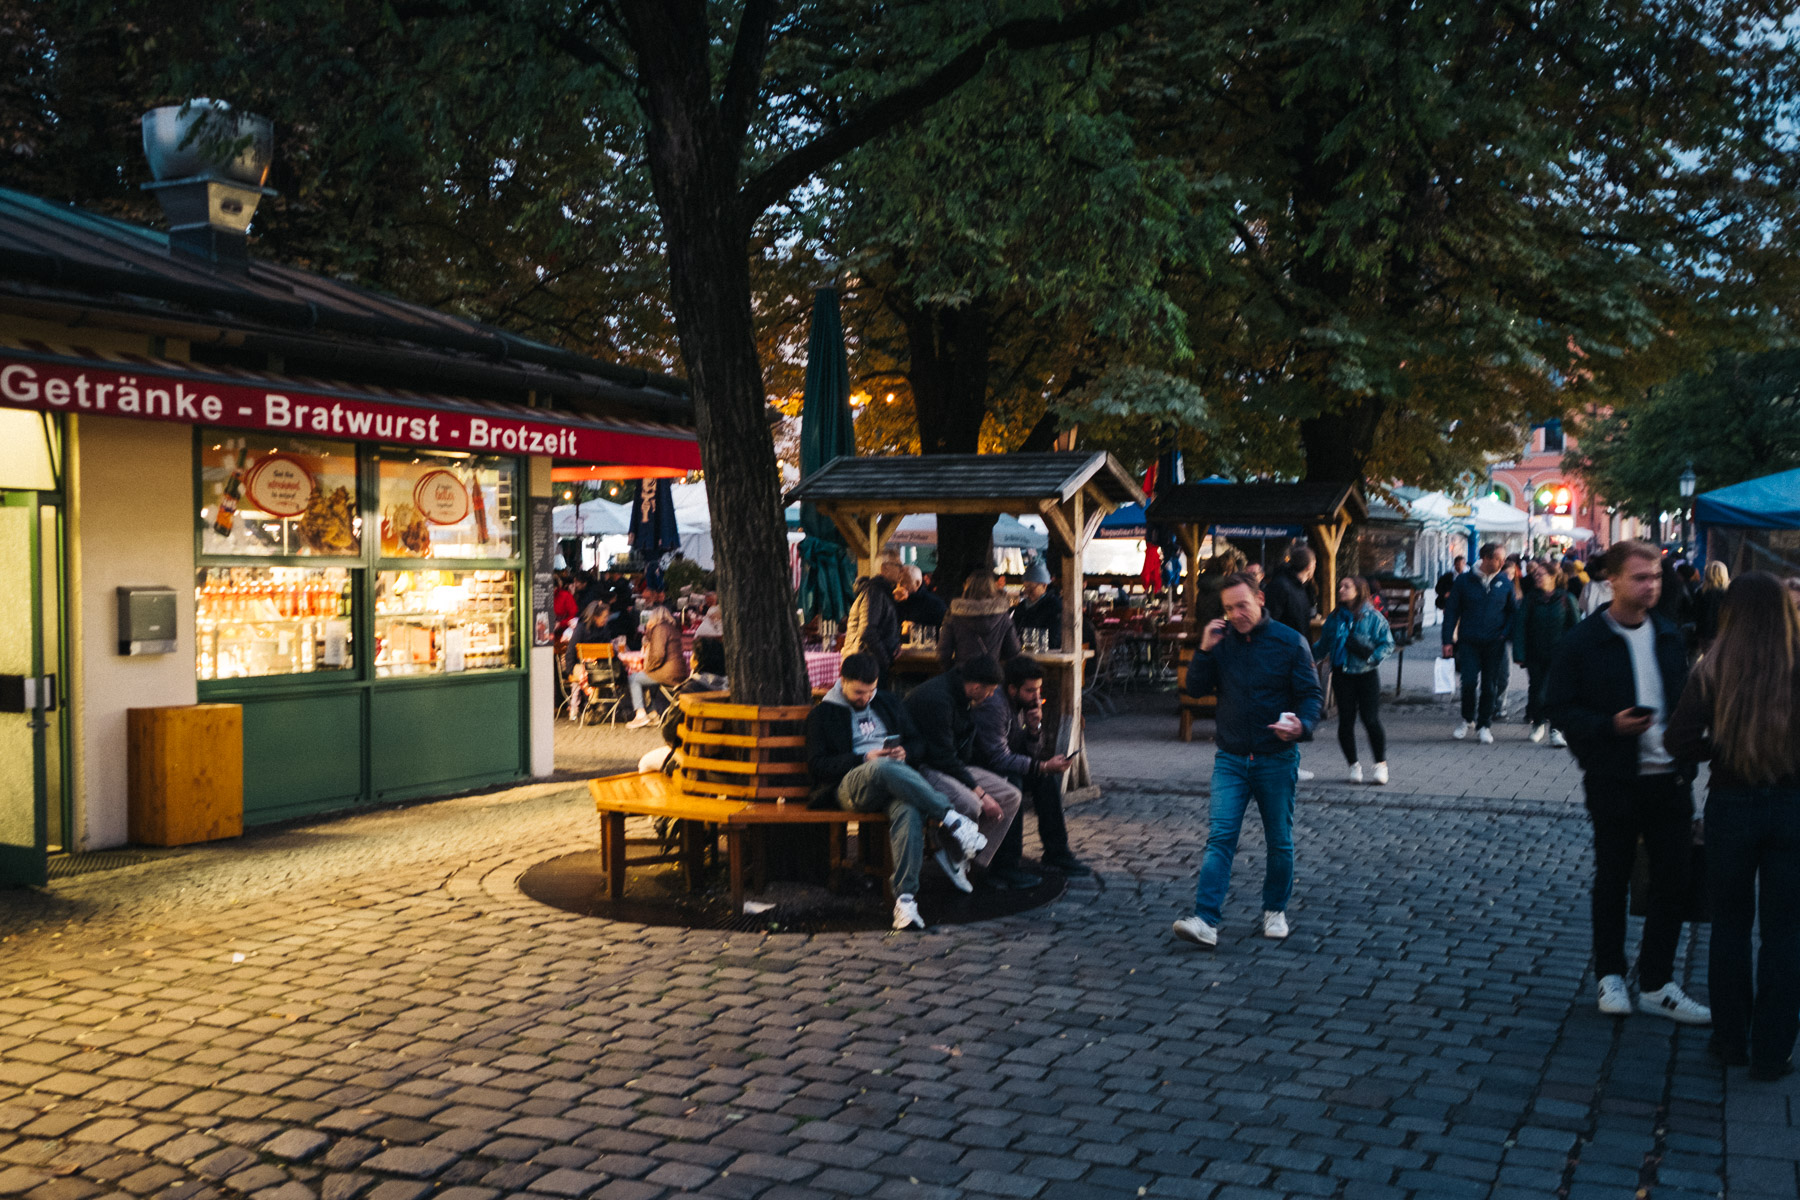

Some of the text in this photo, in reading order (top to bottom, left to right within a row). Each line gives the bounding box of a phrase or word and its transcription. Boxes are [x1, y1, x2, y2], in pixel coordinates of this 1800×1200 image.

[0, 363, 223, 421] Getränke
[264, 393, 441, 443] Bratwurst
[468, 417, 578, 457] Brotzeit
